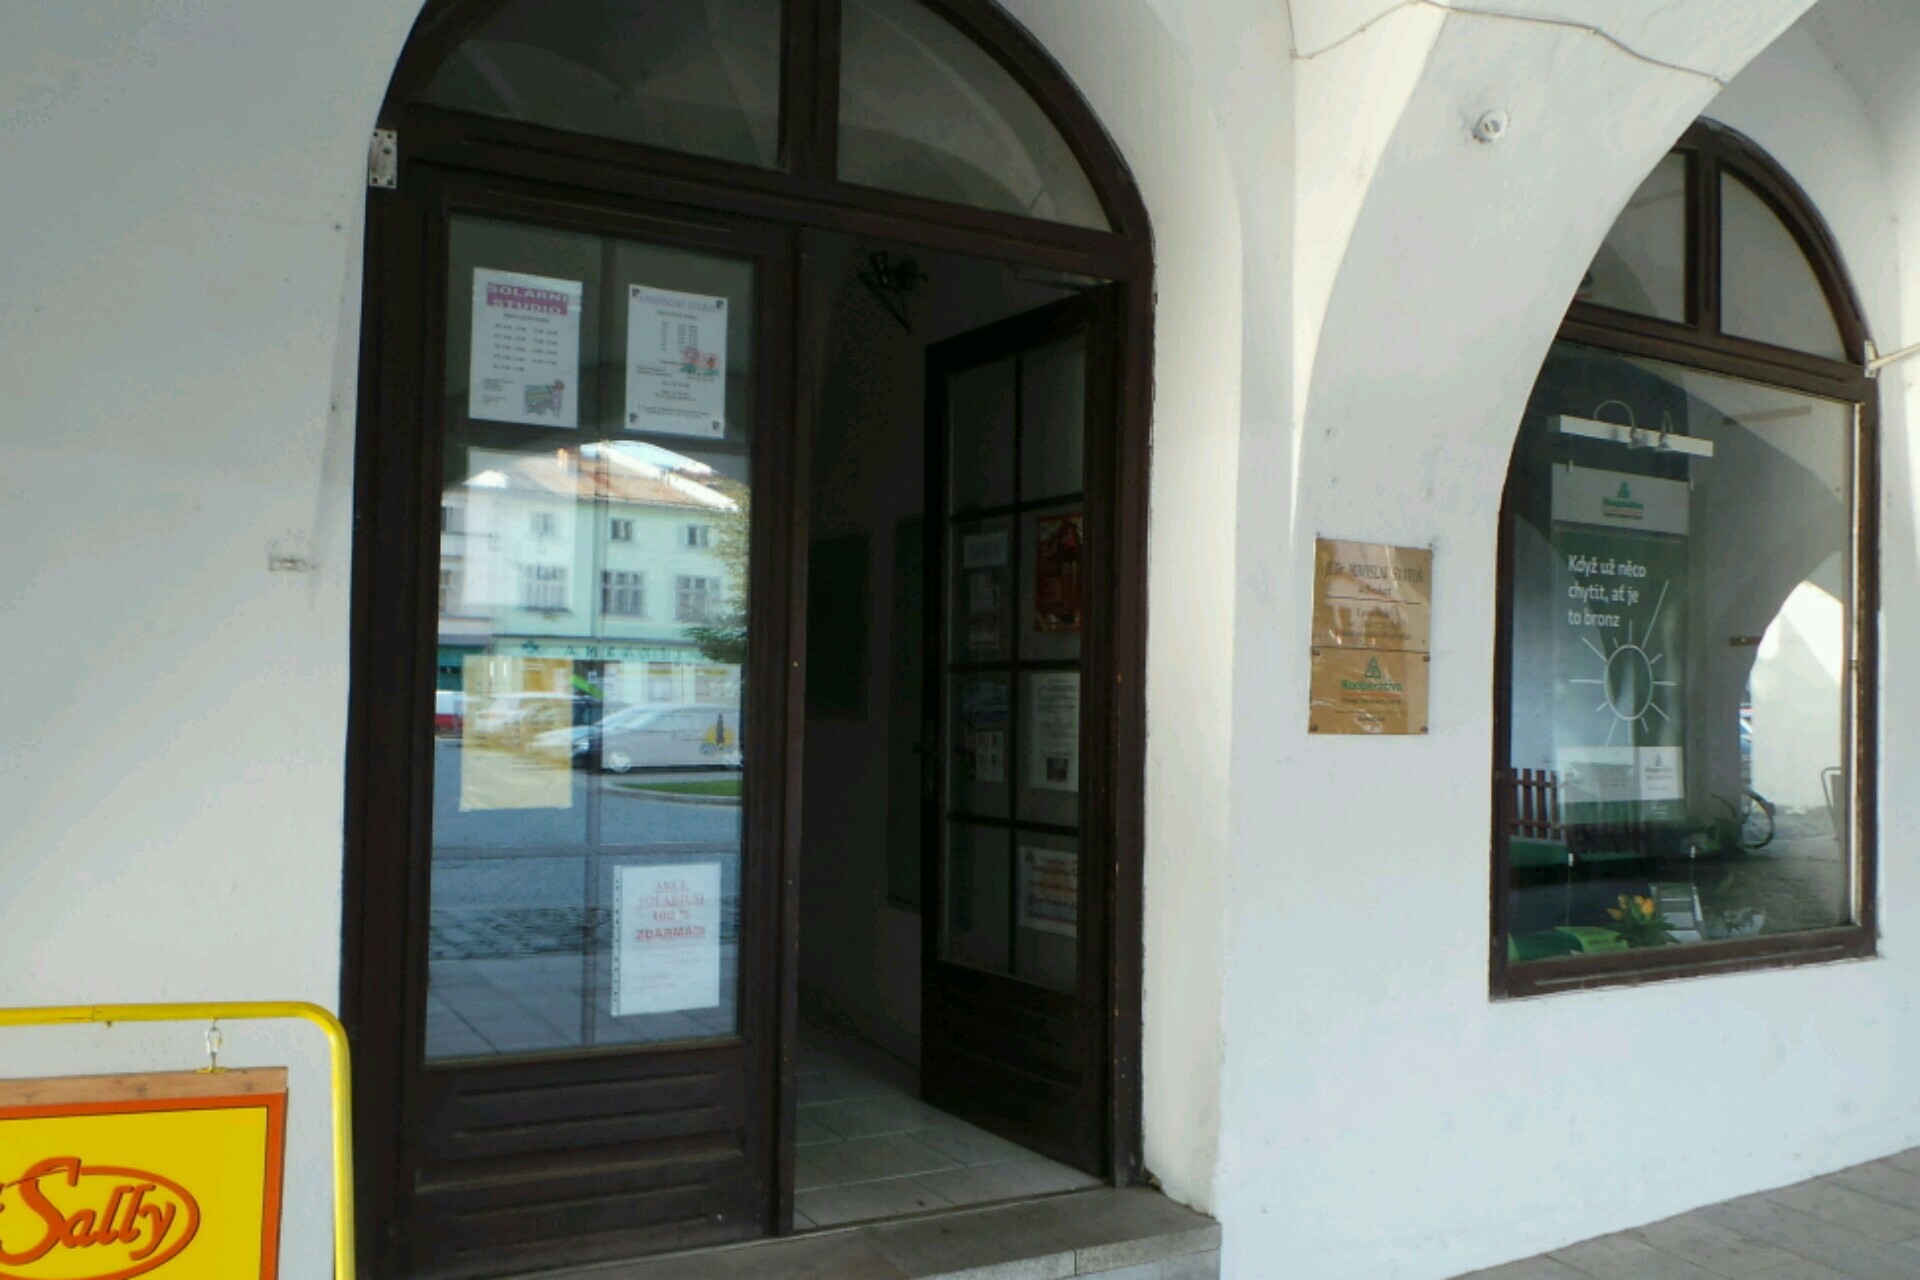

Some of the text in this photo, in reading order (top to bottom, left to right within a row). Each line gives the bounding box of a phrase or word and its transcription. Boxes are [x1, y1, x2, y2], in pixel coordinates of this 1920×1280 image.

[1568, 555, 1646, 577] Když už něco
[1568, 581, 1638, 606] chytit, ať je
[1568, 608, 1621, 627] to bronz
[0, 1156, 177, 1266] Sally
